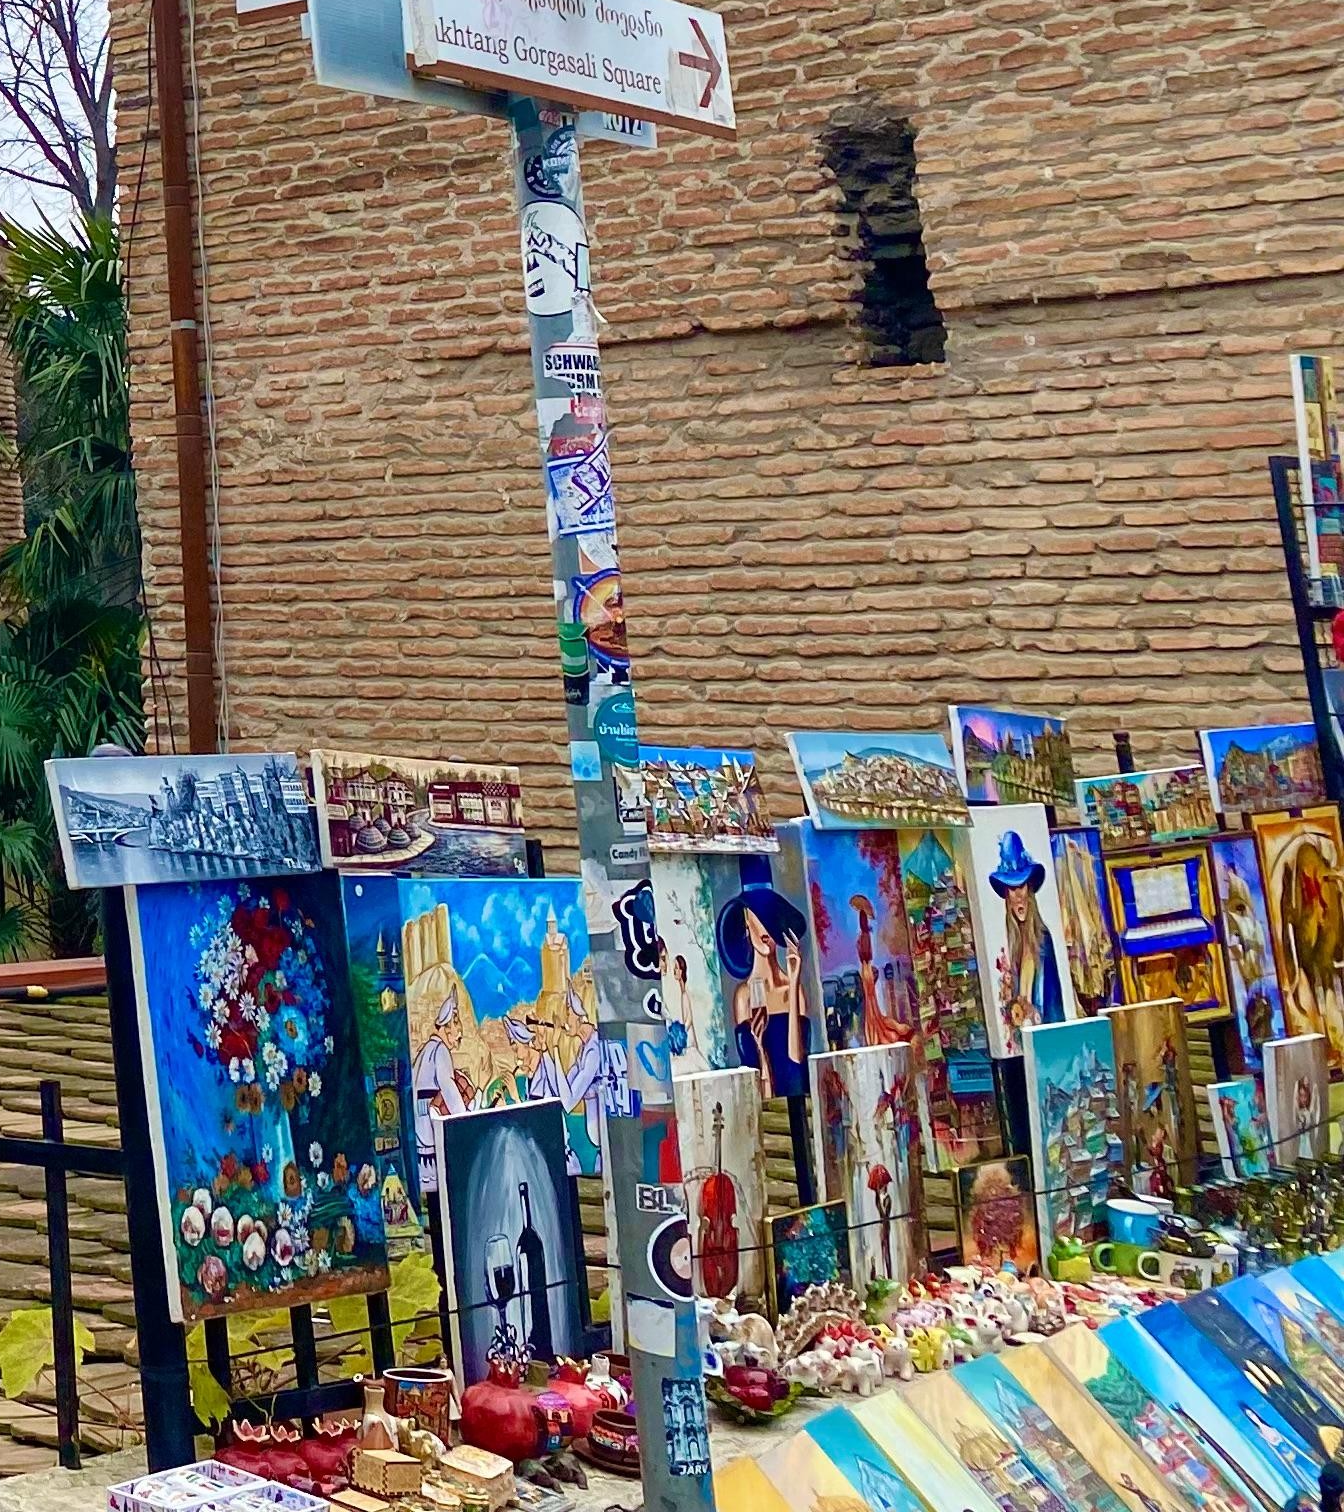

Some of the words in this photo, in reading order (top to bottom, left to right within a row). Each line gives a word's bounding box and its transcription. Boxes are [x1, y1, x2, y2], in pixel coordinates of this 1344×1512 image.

[435, 17, 509, 64] khtang
[513, 36, 597, 78] Gorgasali
[602, 58, 662, 95] Square
